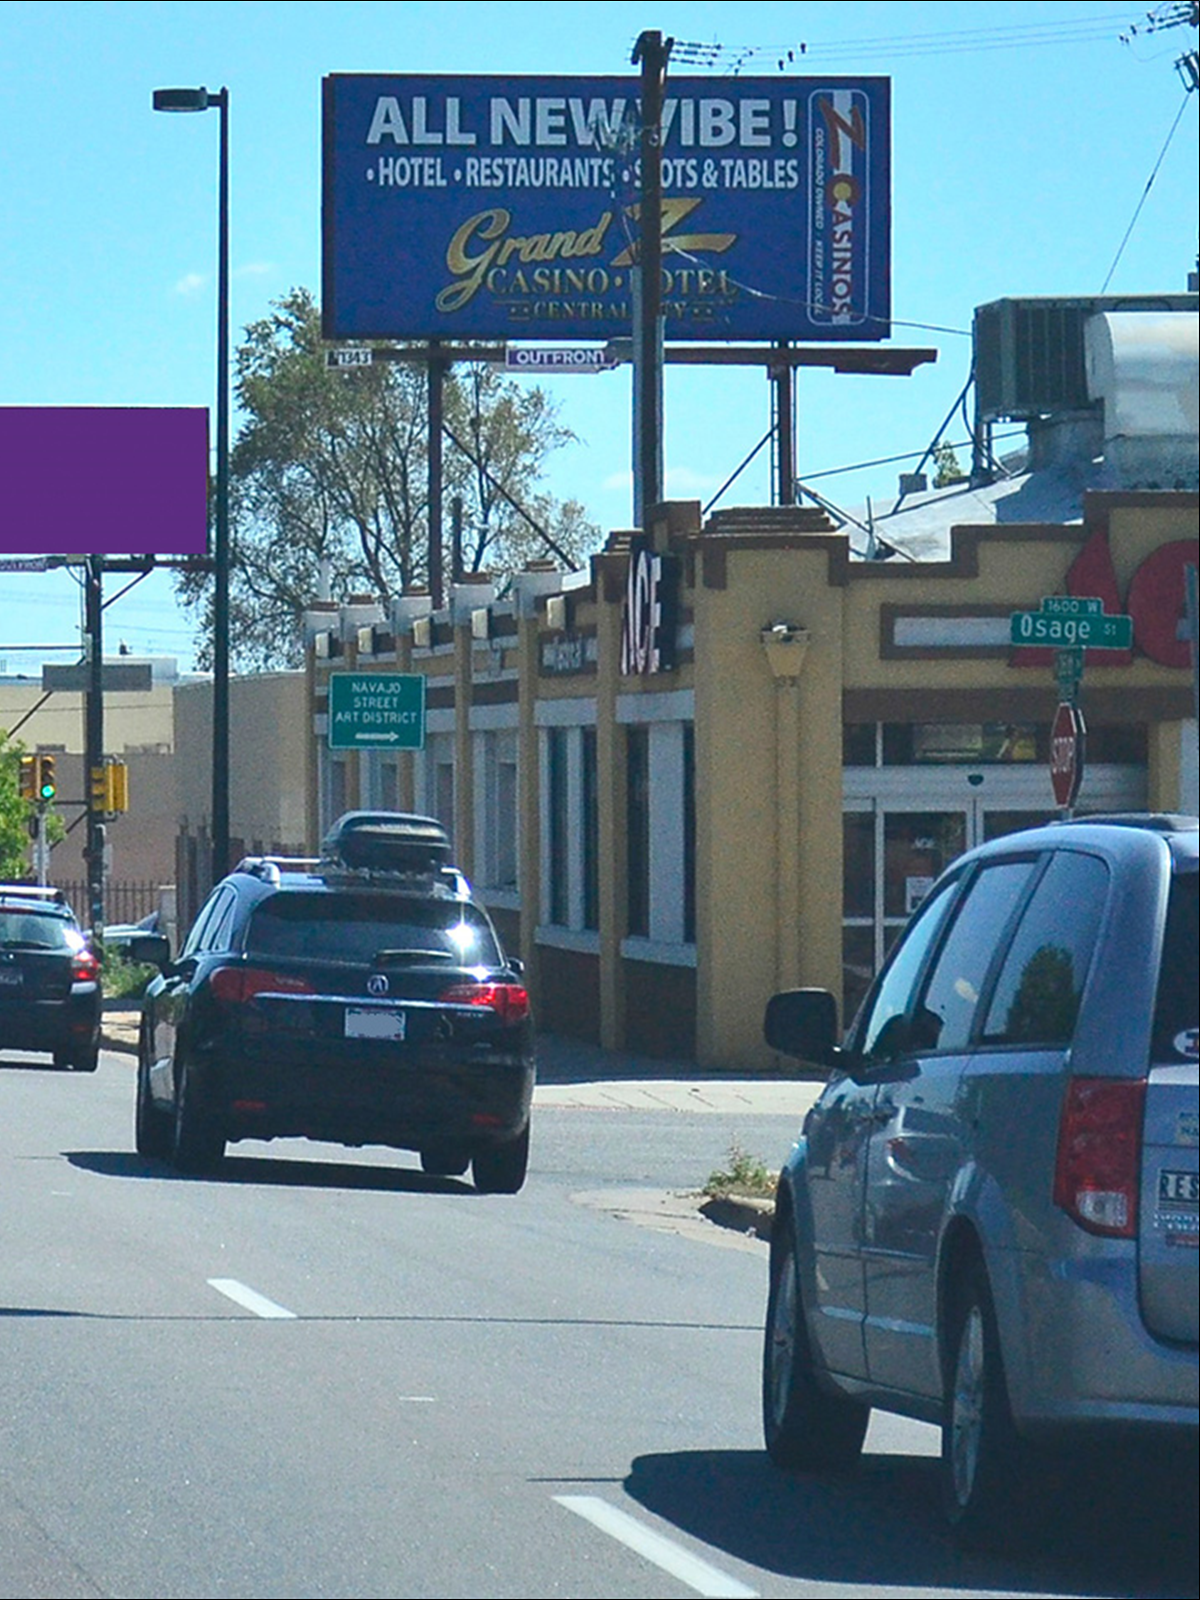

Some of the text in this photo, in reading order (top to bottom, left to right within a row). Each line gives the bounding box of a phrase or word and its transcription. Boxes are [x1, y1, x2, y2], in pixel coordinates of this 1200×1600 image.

[366, 96, 477, 145] ALL
[490, 97, 628, 146] NEW
[378, 156, 799, 189] HOTEL RESTAURANTS SOTS & TABLES
[826, 173, 862, 317] CASINOS
[435, 208, 612, 312] Grand
[487, 267, 738, 296] CASINO OTEL
[533, 302, 631, 320] CENTRAL
[1048, 600, 1099, 613] 1600 W
[1020, 614, 1091, 644] Osage
[351, 682, 402, 694] NAVAJO
[353, 696, 399, 709] STREET
[334, 711, 417, 724] ART DISTRICT
